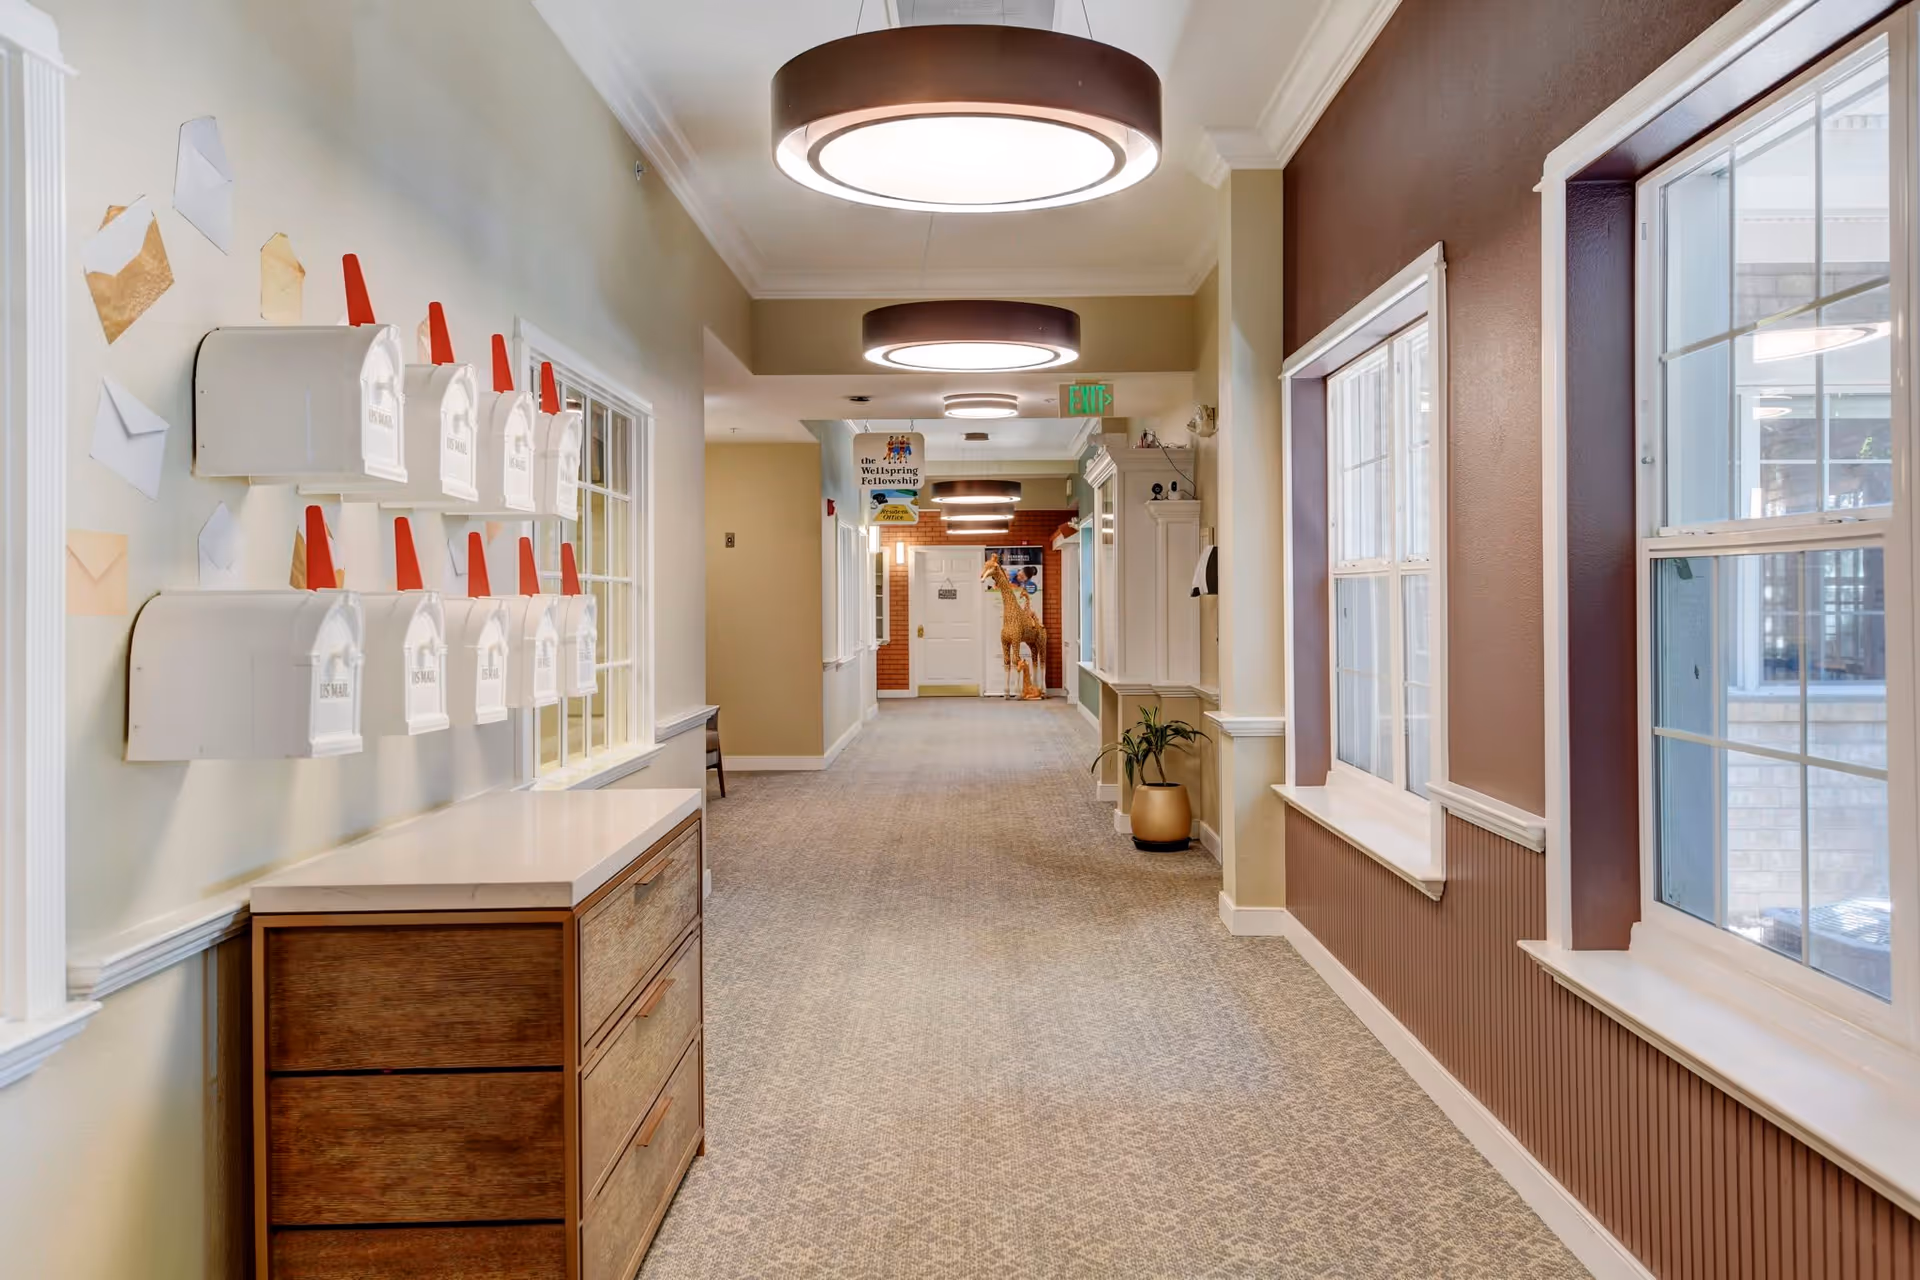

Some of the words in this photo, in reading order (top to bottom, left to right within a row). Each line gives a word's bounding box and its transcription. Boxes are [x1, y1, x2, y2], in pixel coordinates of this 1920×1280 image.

[1068, 385, 1105, 415] EXIT
[861, 466, 919, 477] Wellspring
[861, 476, 919, 487] Fellowship
[331, 683, 350, 698] MAIL
